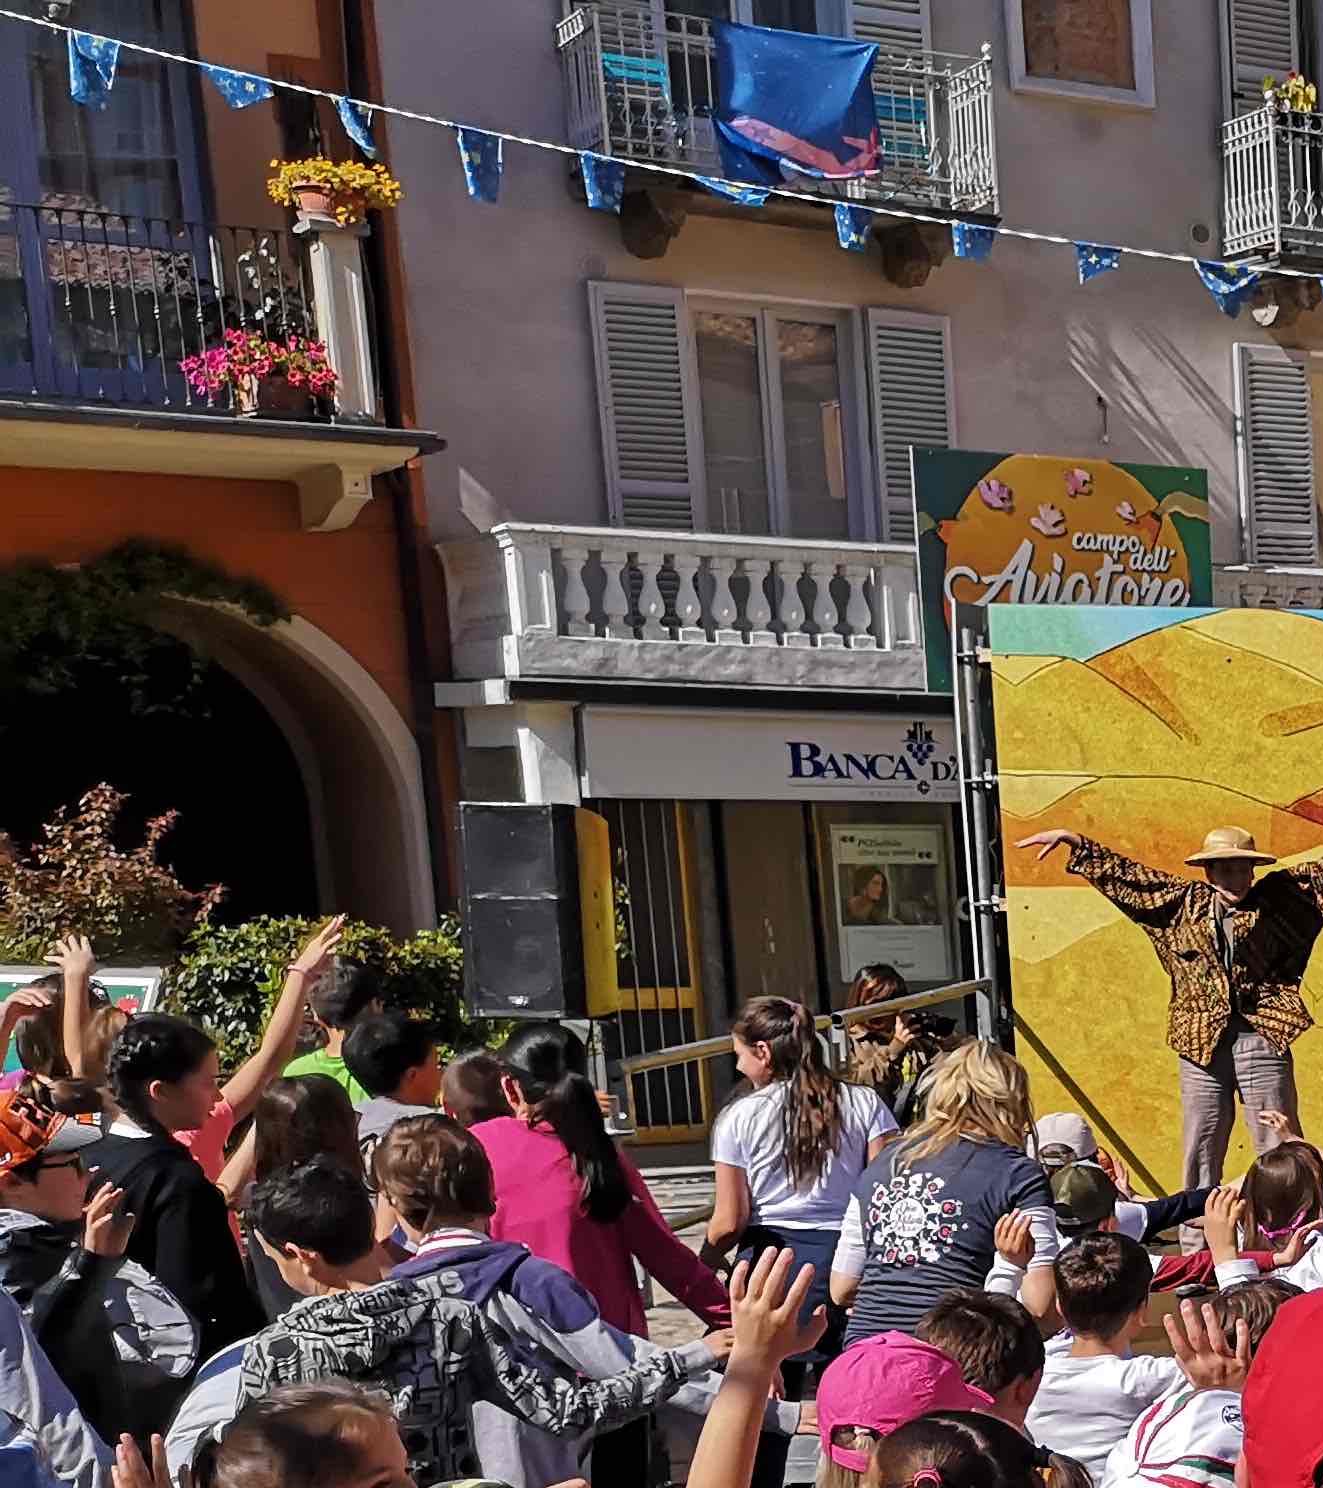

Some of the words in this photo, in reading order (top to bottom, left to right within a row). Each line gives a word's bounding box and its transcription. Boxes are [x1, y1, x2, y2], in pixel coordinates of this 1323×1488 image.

[1072, 531, 1140, 560] campo
[943, 538, 1191, 607] Aviatore
[785, 741, 918, 781] BANCA
